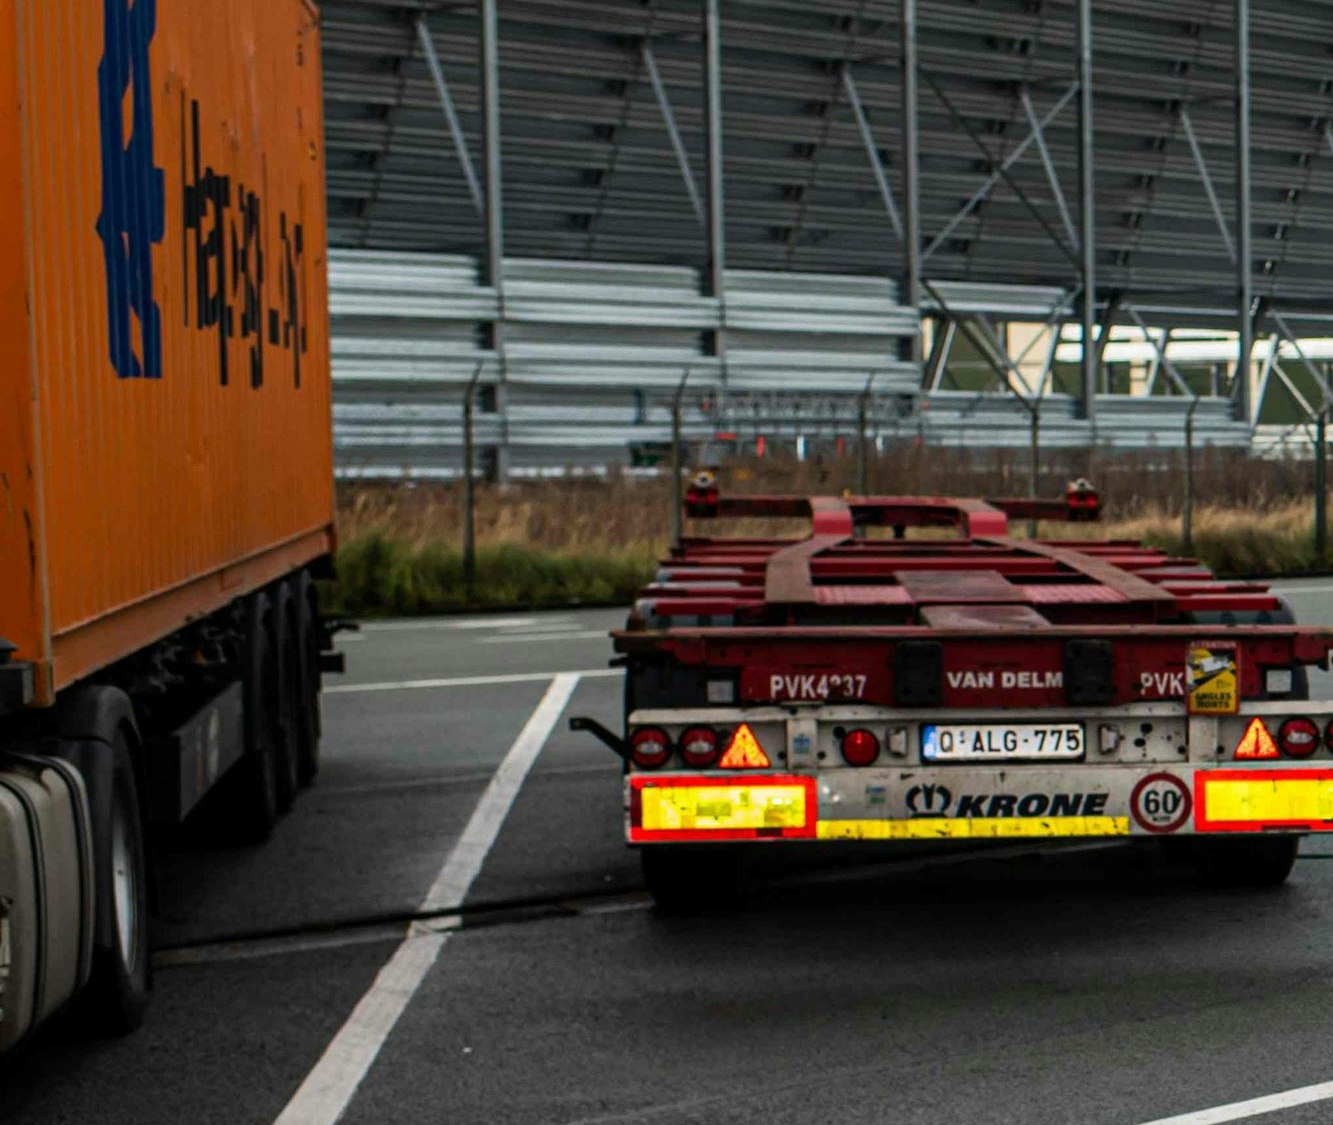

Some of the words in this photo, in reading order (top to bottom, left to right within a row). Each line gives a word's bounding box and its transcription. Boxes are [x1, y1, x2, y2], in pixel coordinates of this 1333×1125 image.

[946, 671, 995, 689] VAN
[1001, 671, 1064, 689] DELM
[956, 792, 1110, 818] KRONE
[1143, 790, 1180, 815] 60
